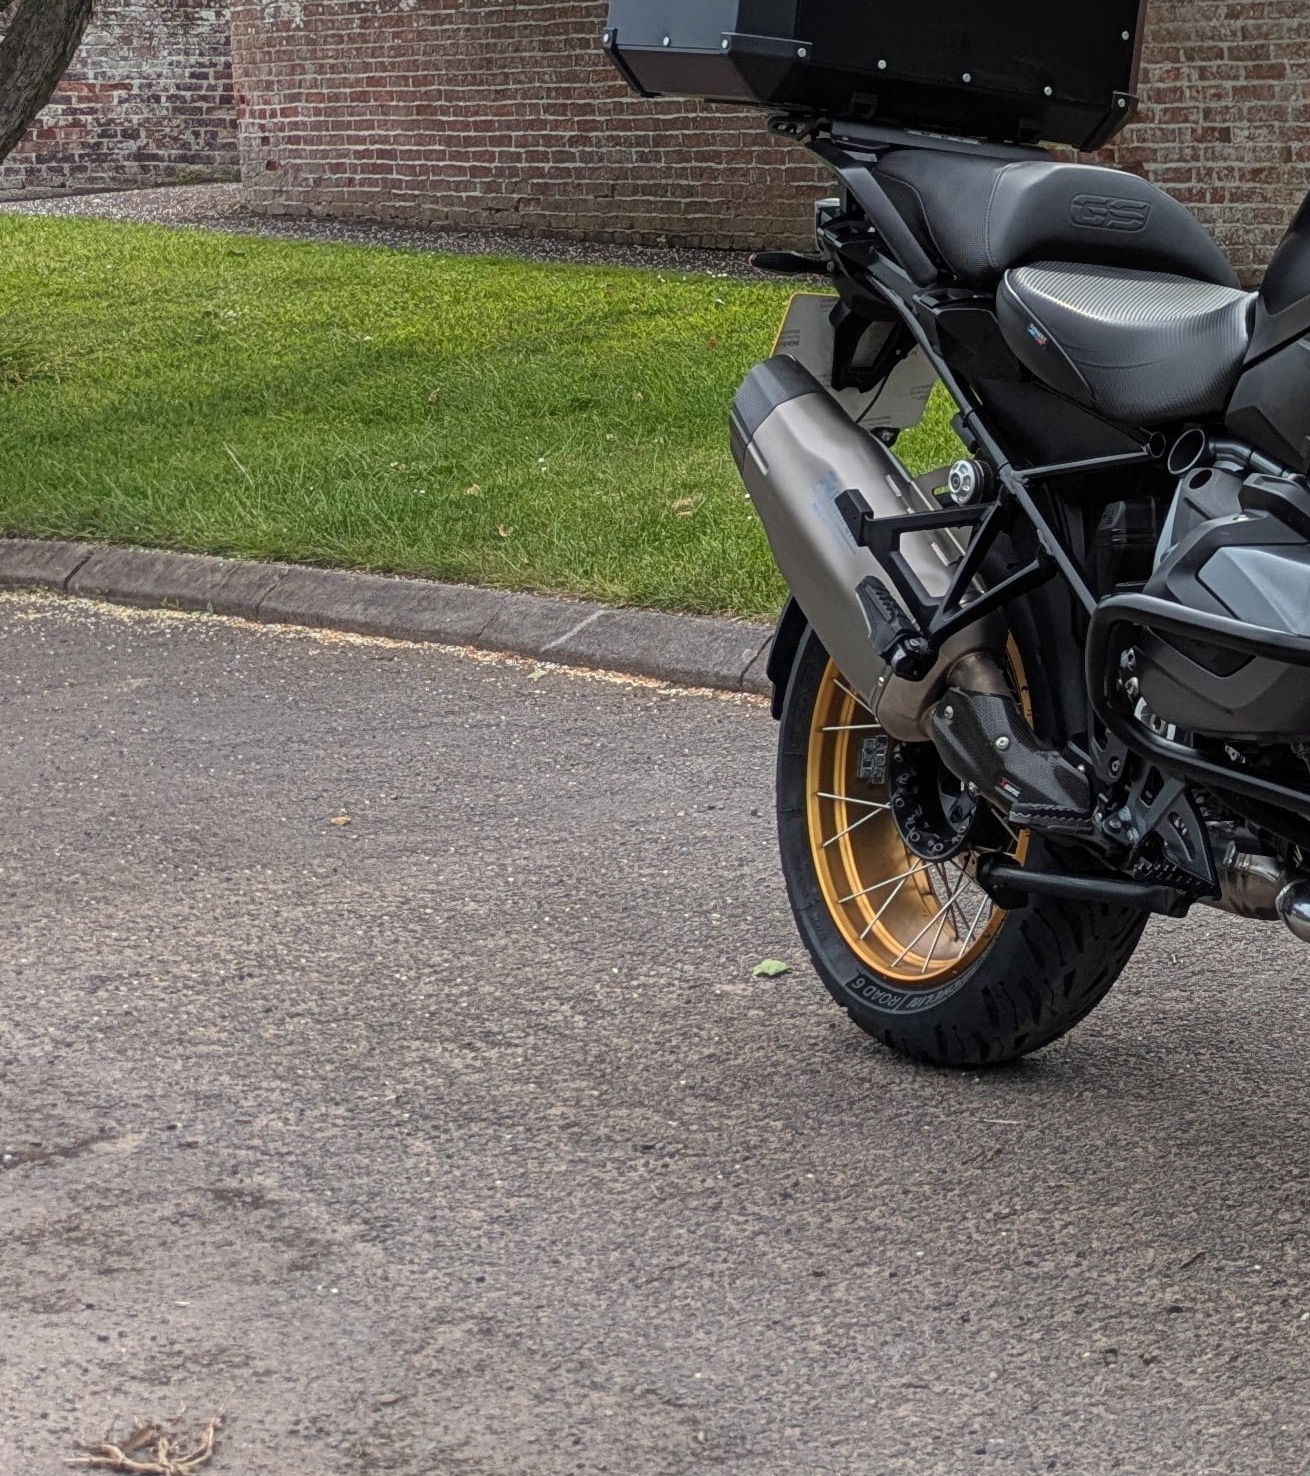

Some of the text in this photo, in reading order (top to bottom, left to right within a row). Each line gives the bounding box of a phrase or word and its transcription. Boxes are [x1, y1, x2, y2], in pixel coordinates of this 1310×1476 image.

[1069, 193, 1153, 234] GS
[851, 977, 866, 989] 6
[862, 985, 902, 1007] ROAD
